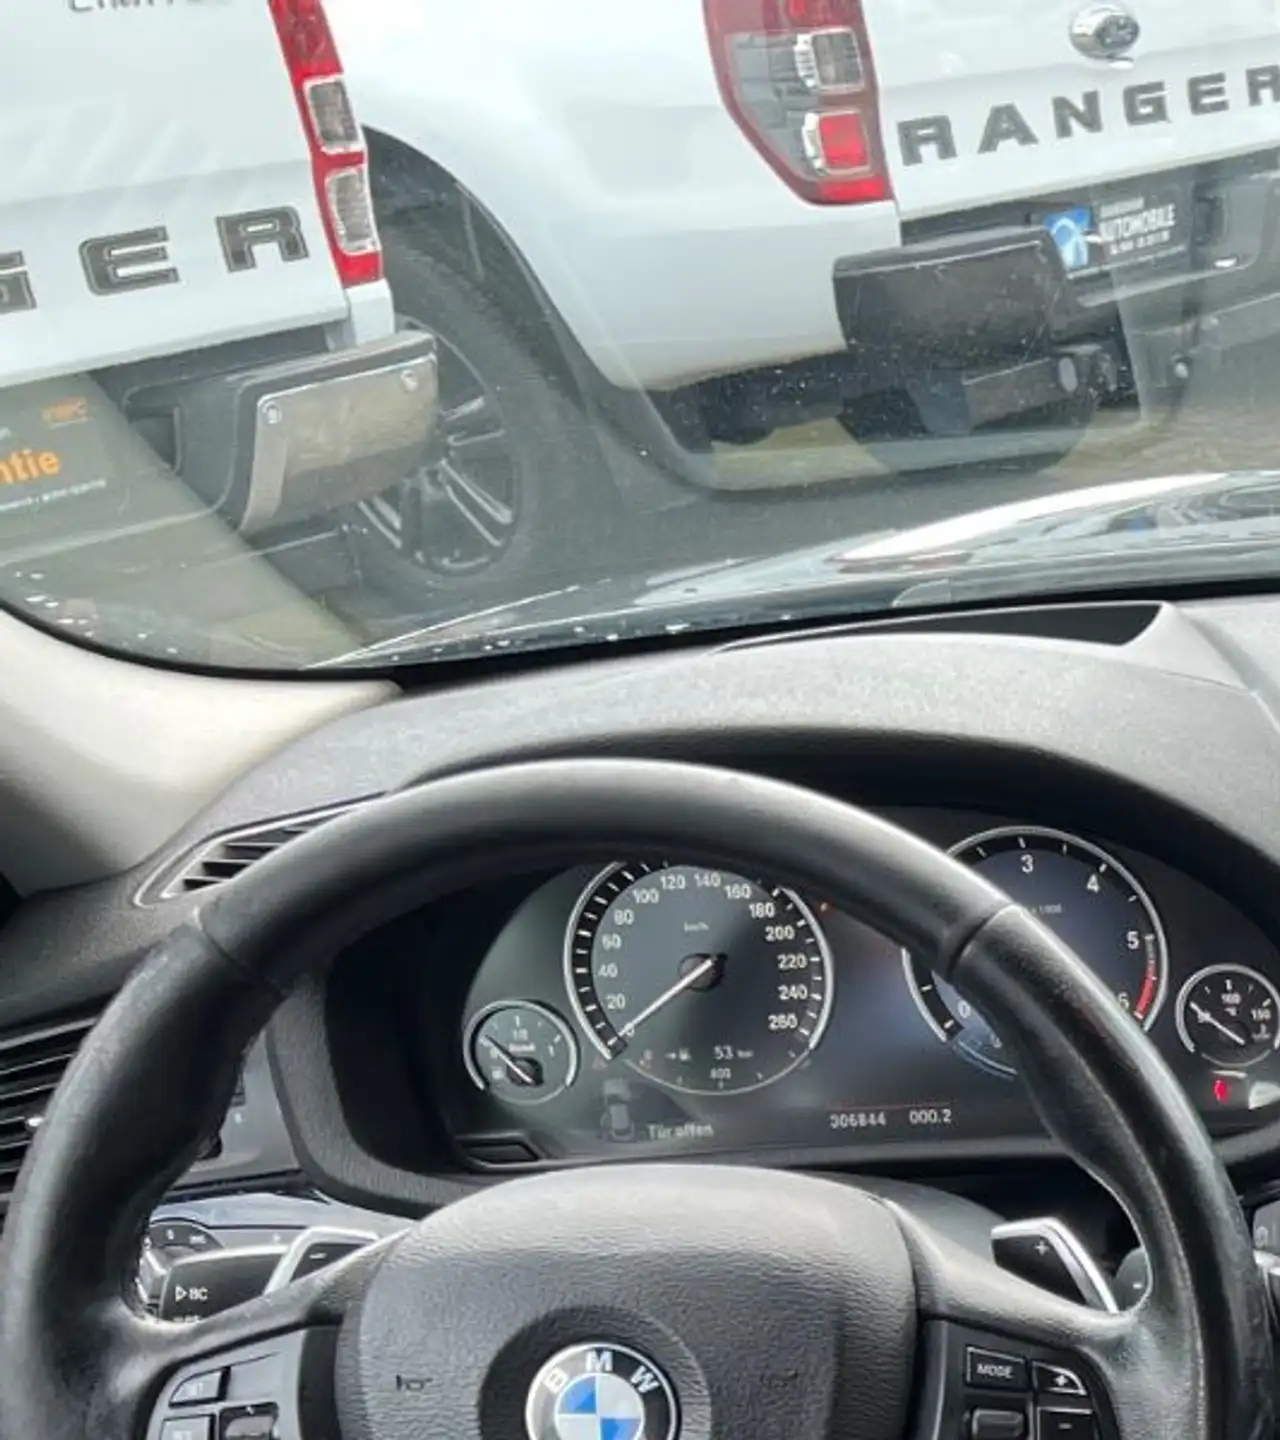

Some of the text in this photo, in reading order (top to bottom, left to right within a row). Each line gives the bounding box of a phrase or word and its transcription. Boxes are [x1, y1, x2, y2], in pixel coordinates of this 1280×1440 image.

[1021, 855, 1034, 873] 3
[660, 876, 686, 890] 120
[694, 873, 721, 888] 140
[1087, 874, 1100, 893] 4
[632, 888, 659, 904] 100
[724, 885, 752, 899] 160
[614, 910, 635, 925] 80
[749, 903, 775, 918] 180
[765, 926, 795, 941] 200
[1126, 932, 1139, 949] 5
[777, 955, 807, 969] 220
[599, 964, 618, 978] 40
[778, 986, 808, 1000] 240
[607, 995, 625, 1009] 20
[768, 1014, 798, 1030] 260
[714, 1046, 733, 1060] 53
[909, 1108, 952, 1125] 000.2
[544, 1349, 661, 1395] BMW
[977, 1364, 1014, 1379] MODE
